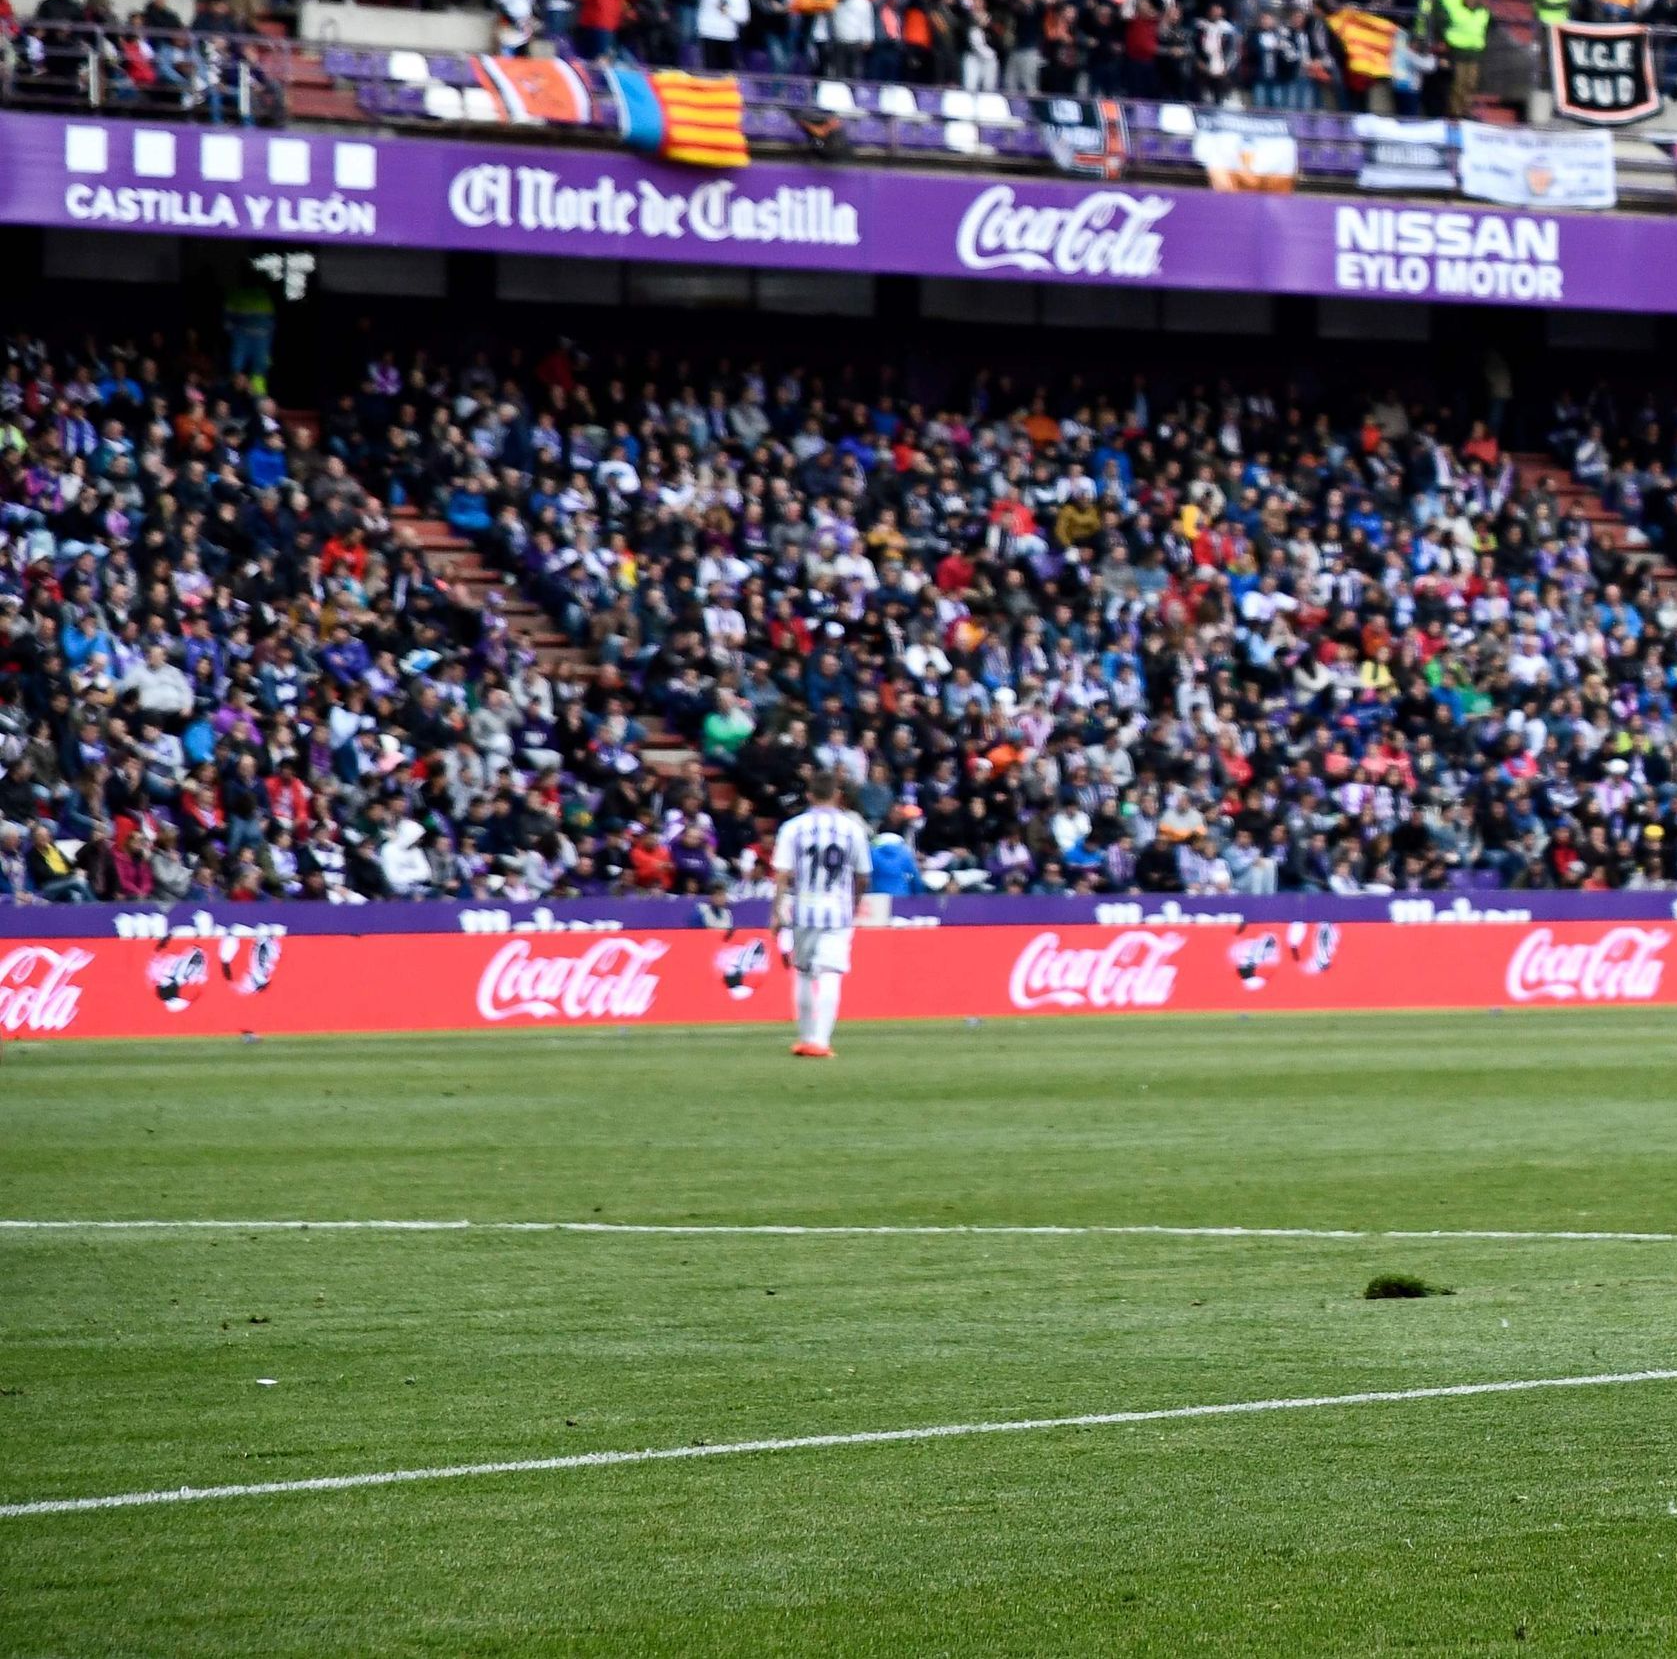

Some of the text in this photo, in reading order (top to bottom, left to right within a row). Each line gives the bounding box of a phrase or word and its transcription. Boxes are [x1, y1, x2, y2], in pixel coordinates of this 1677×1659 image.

[66, 182, 377, 237] CASTILLA Y LEÓN
[449, 165, 860, 246] El Norte de Castilla
[956, 184, 1175, 278] Coca-Cola
[1334, 206, 1561, 263] NISSAN
[1334, 251, 1564, 302] EYLO MOTOR
[805, 842, 844, 892] 19
[476, 938, 670, 1022] Coca-Cola
[1009, 930, 1187, 1009] Coca-Cola
[1506, 926, 1673, 1001] Coca-Cola
